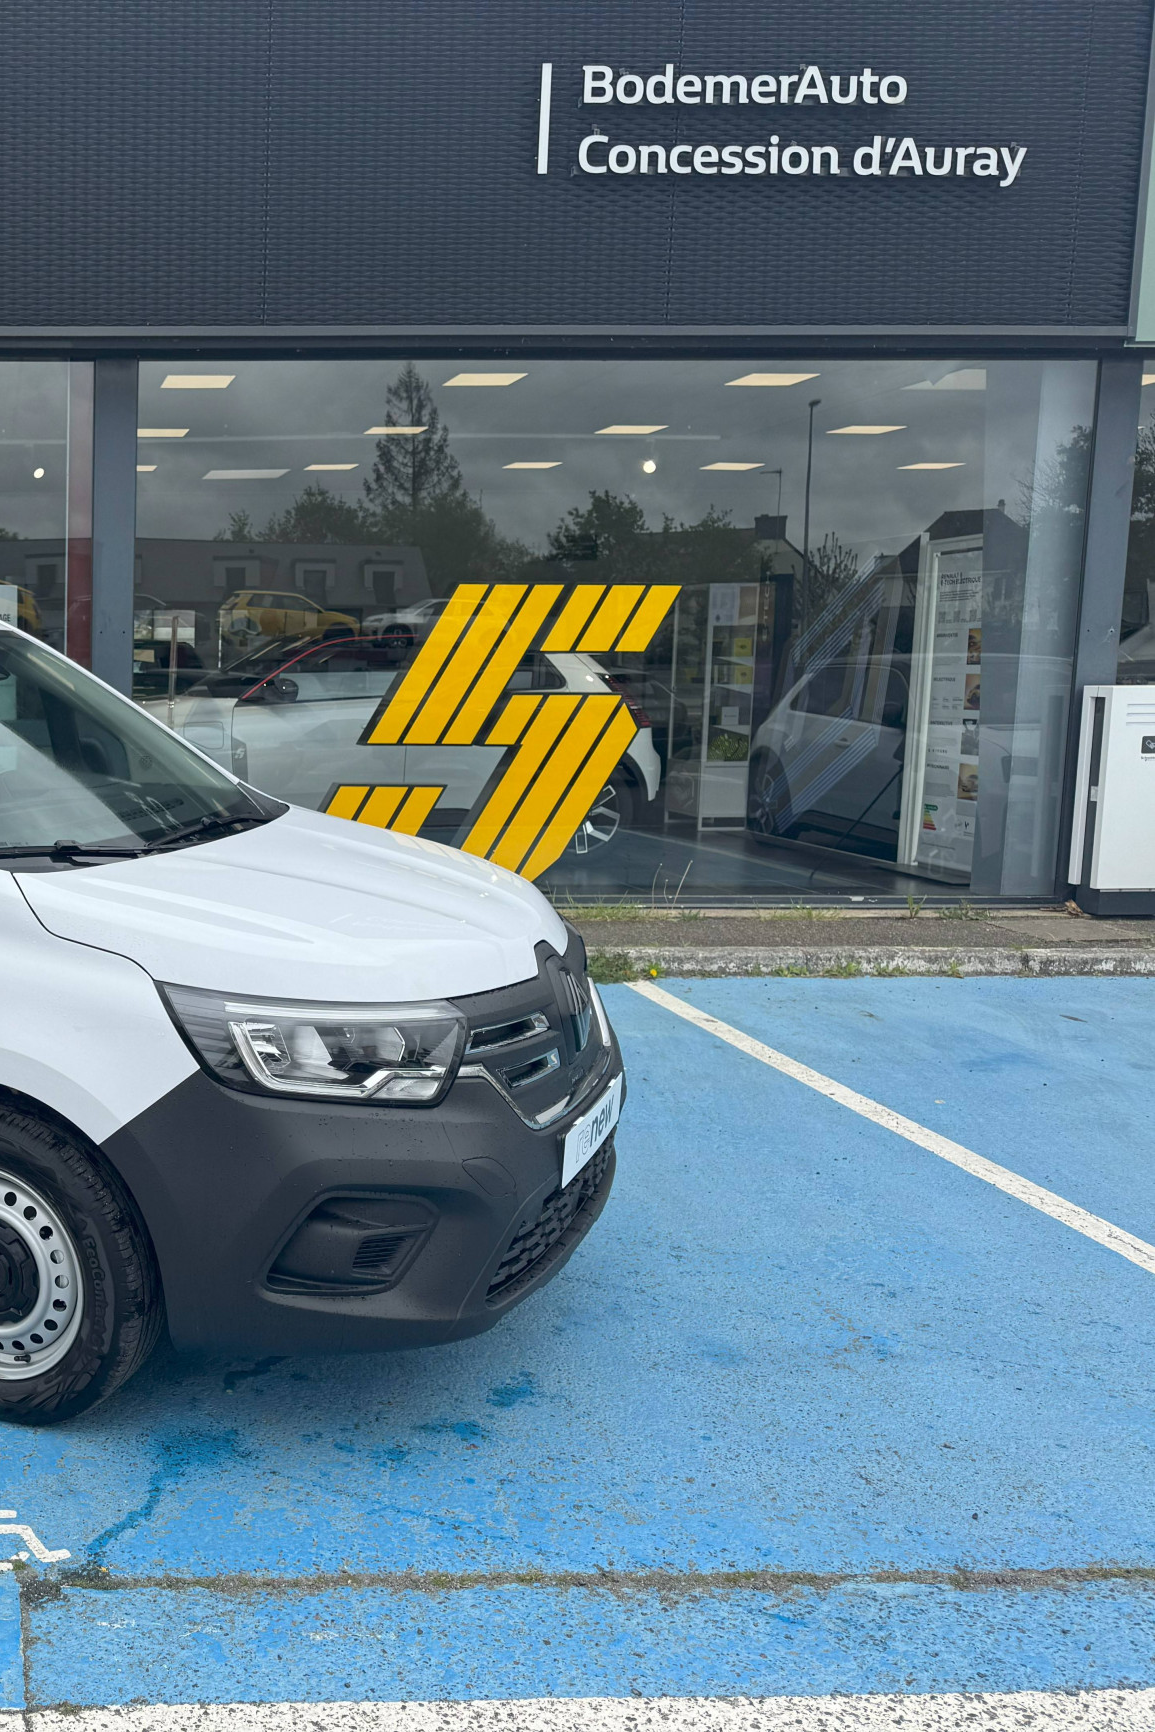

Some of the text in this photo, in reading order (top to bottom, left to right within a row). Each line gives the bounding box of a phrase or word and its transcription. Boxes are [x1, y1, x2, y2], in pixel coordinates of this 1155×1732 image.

[582, 63, 908, 105] BodemerAuto
[578, 135, 1028, 187] Concession d'Auray
[575, 1094, 615, 1163] renew
